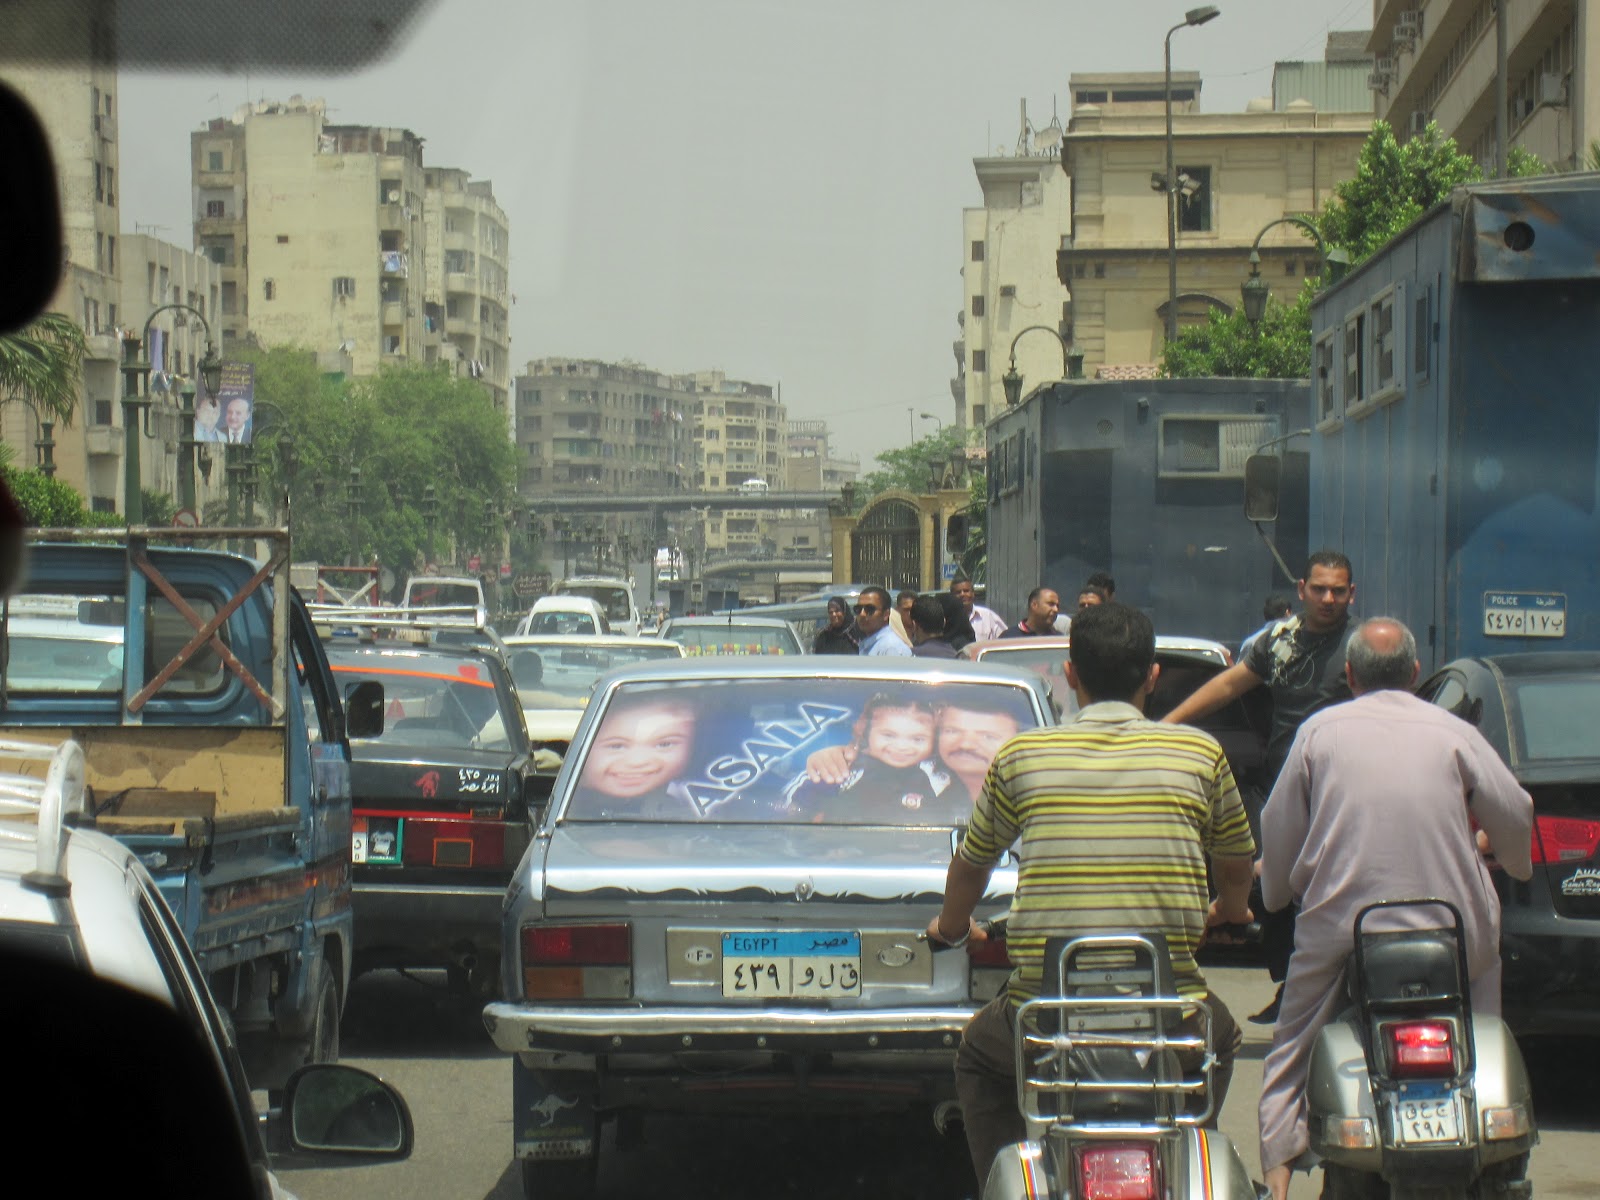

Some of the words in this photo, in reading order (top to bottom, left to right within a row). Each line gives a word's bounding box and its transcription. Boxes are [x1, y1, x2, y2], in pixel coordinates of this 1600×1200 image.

[1492, 596, 1518, 606] POLICE
[685, 703, 850, 817] ASALA
[734, 938, 779, 951] EGYPT
[808, 937, 848, 950] مصر
[734, 963, 780, 991] ٤٣٩
